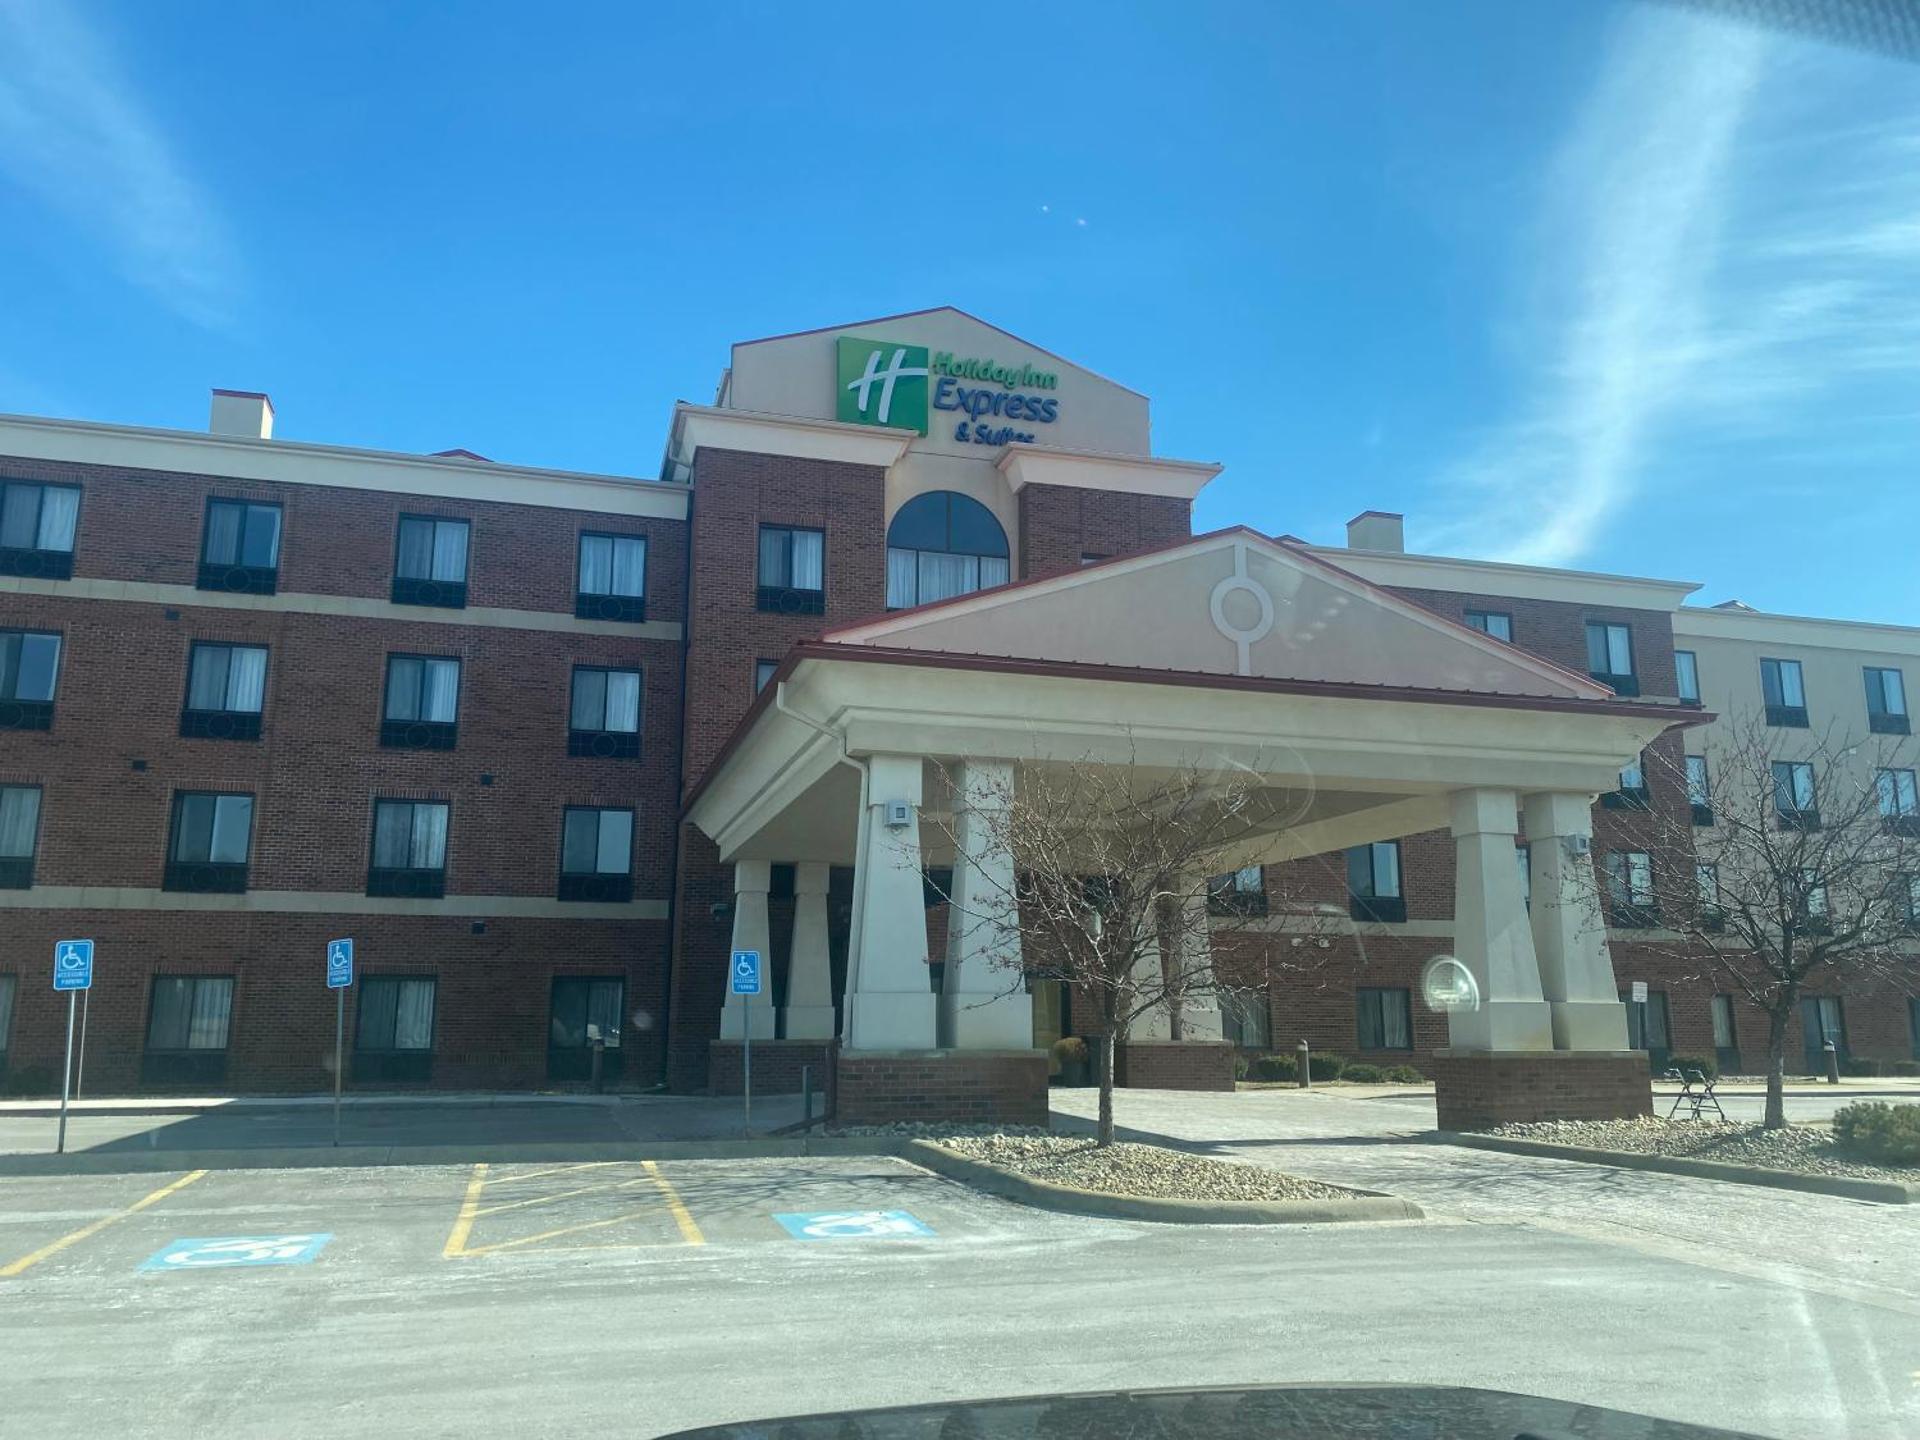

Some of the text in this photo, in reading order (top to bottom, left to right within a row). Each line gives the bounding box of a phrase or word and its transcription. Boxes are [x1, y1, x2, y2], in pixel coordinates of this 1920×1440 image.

[933, 351, 1058, 390] Holiday Inn
[933, 376, 1059, 423] Express
[954, 421, 970, 442] &
